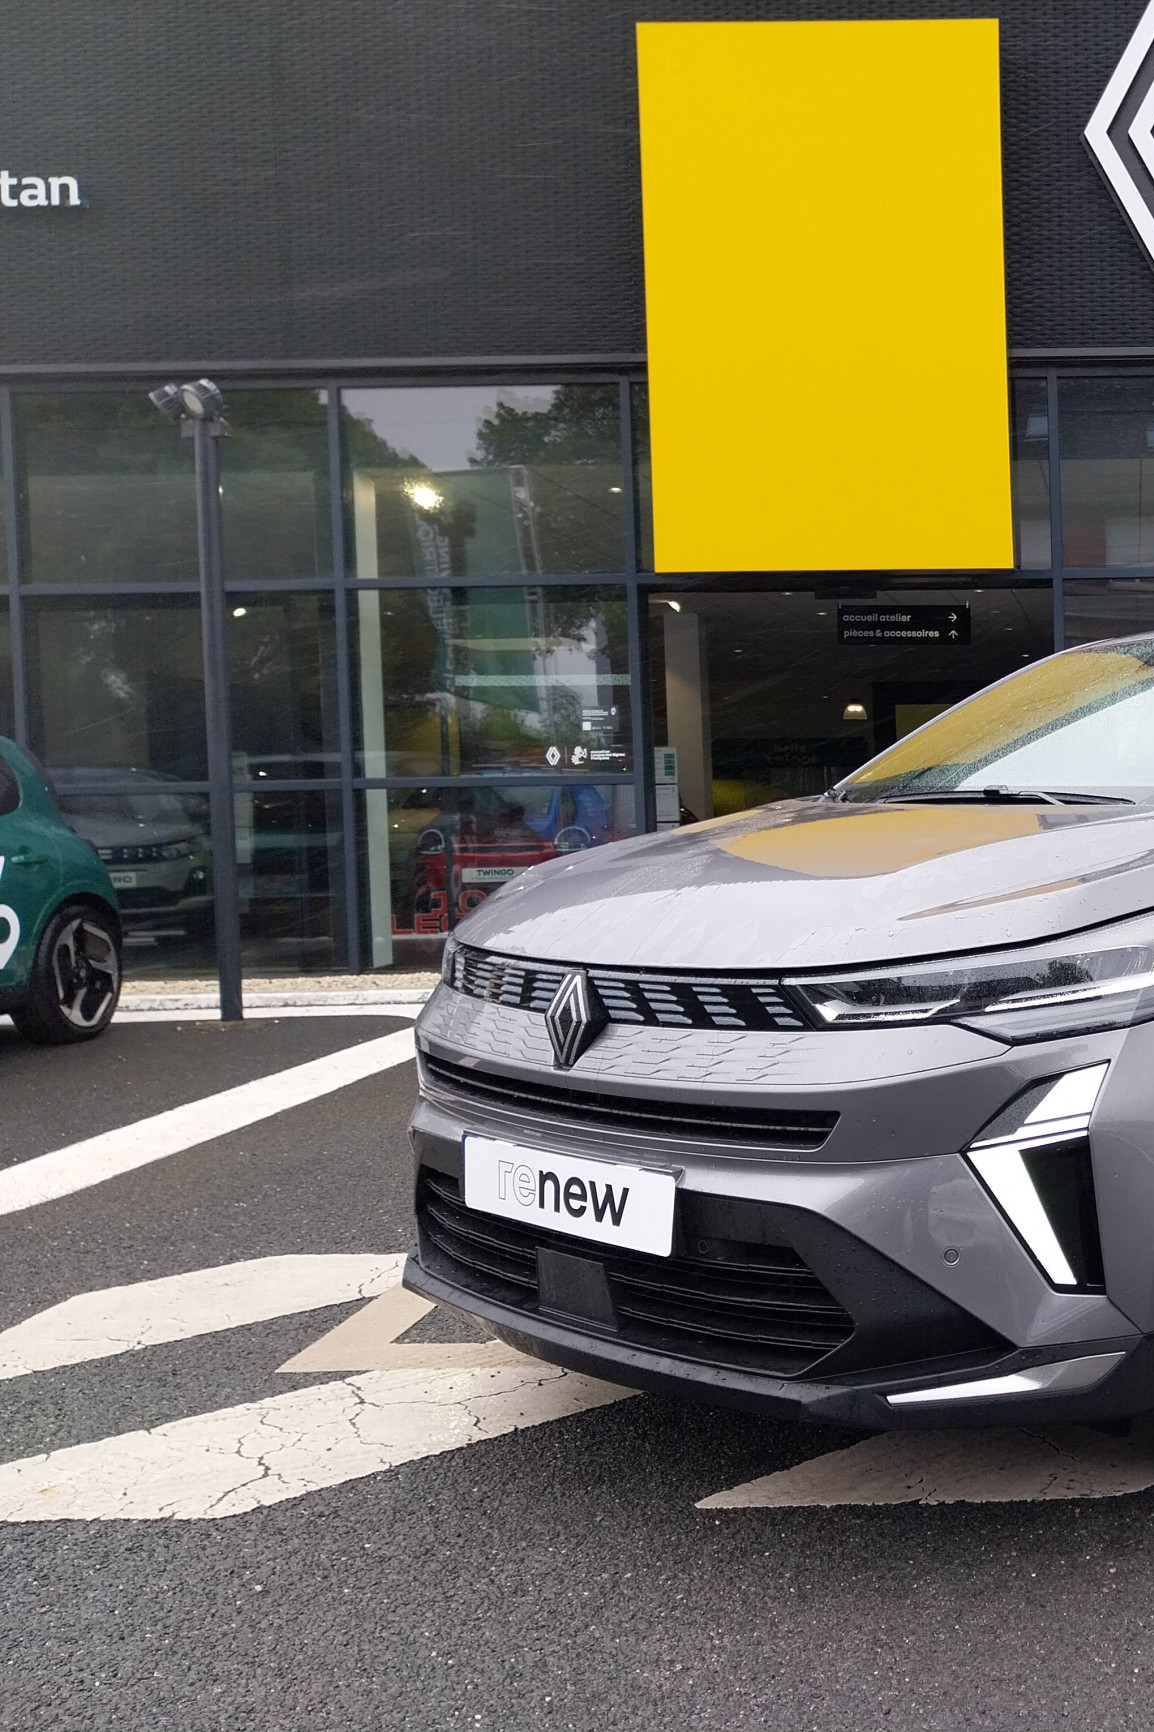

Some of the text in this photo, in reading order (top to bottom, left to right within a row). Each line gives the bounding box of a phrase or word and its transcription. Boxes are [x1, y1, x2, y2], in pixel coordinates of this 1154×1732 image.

[0, 170, 81, 207] tan
[843, 613, 912, 622] accueil atelier
[843, 629, 940, 639] pièces & accessoires
[476, 868, 514, 877] TWINGO
[498, 1159, 630, 1227] renew
